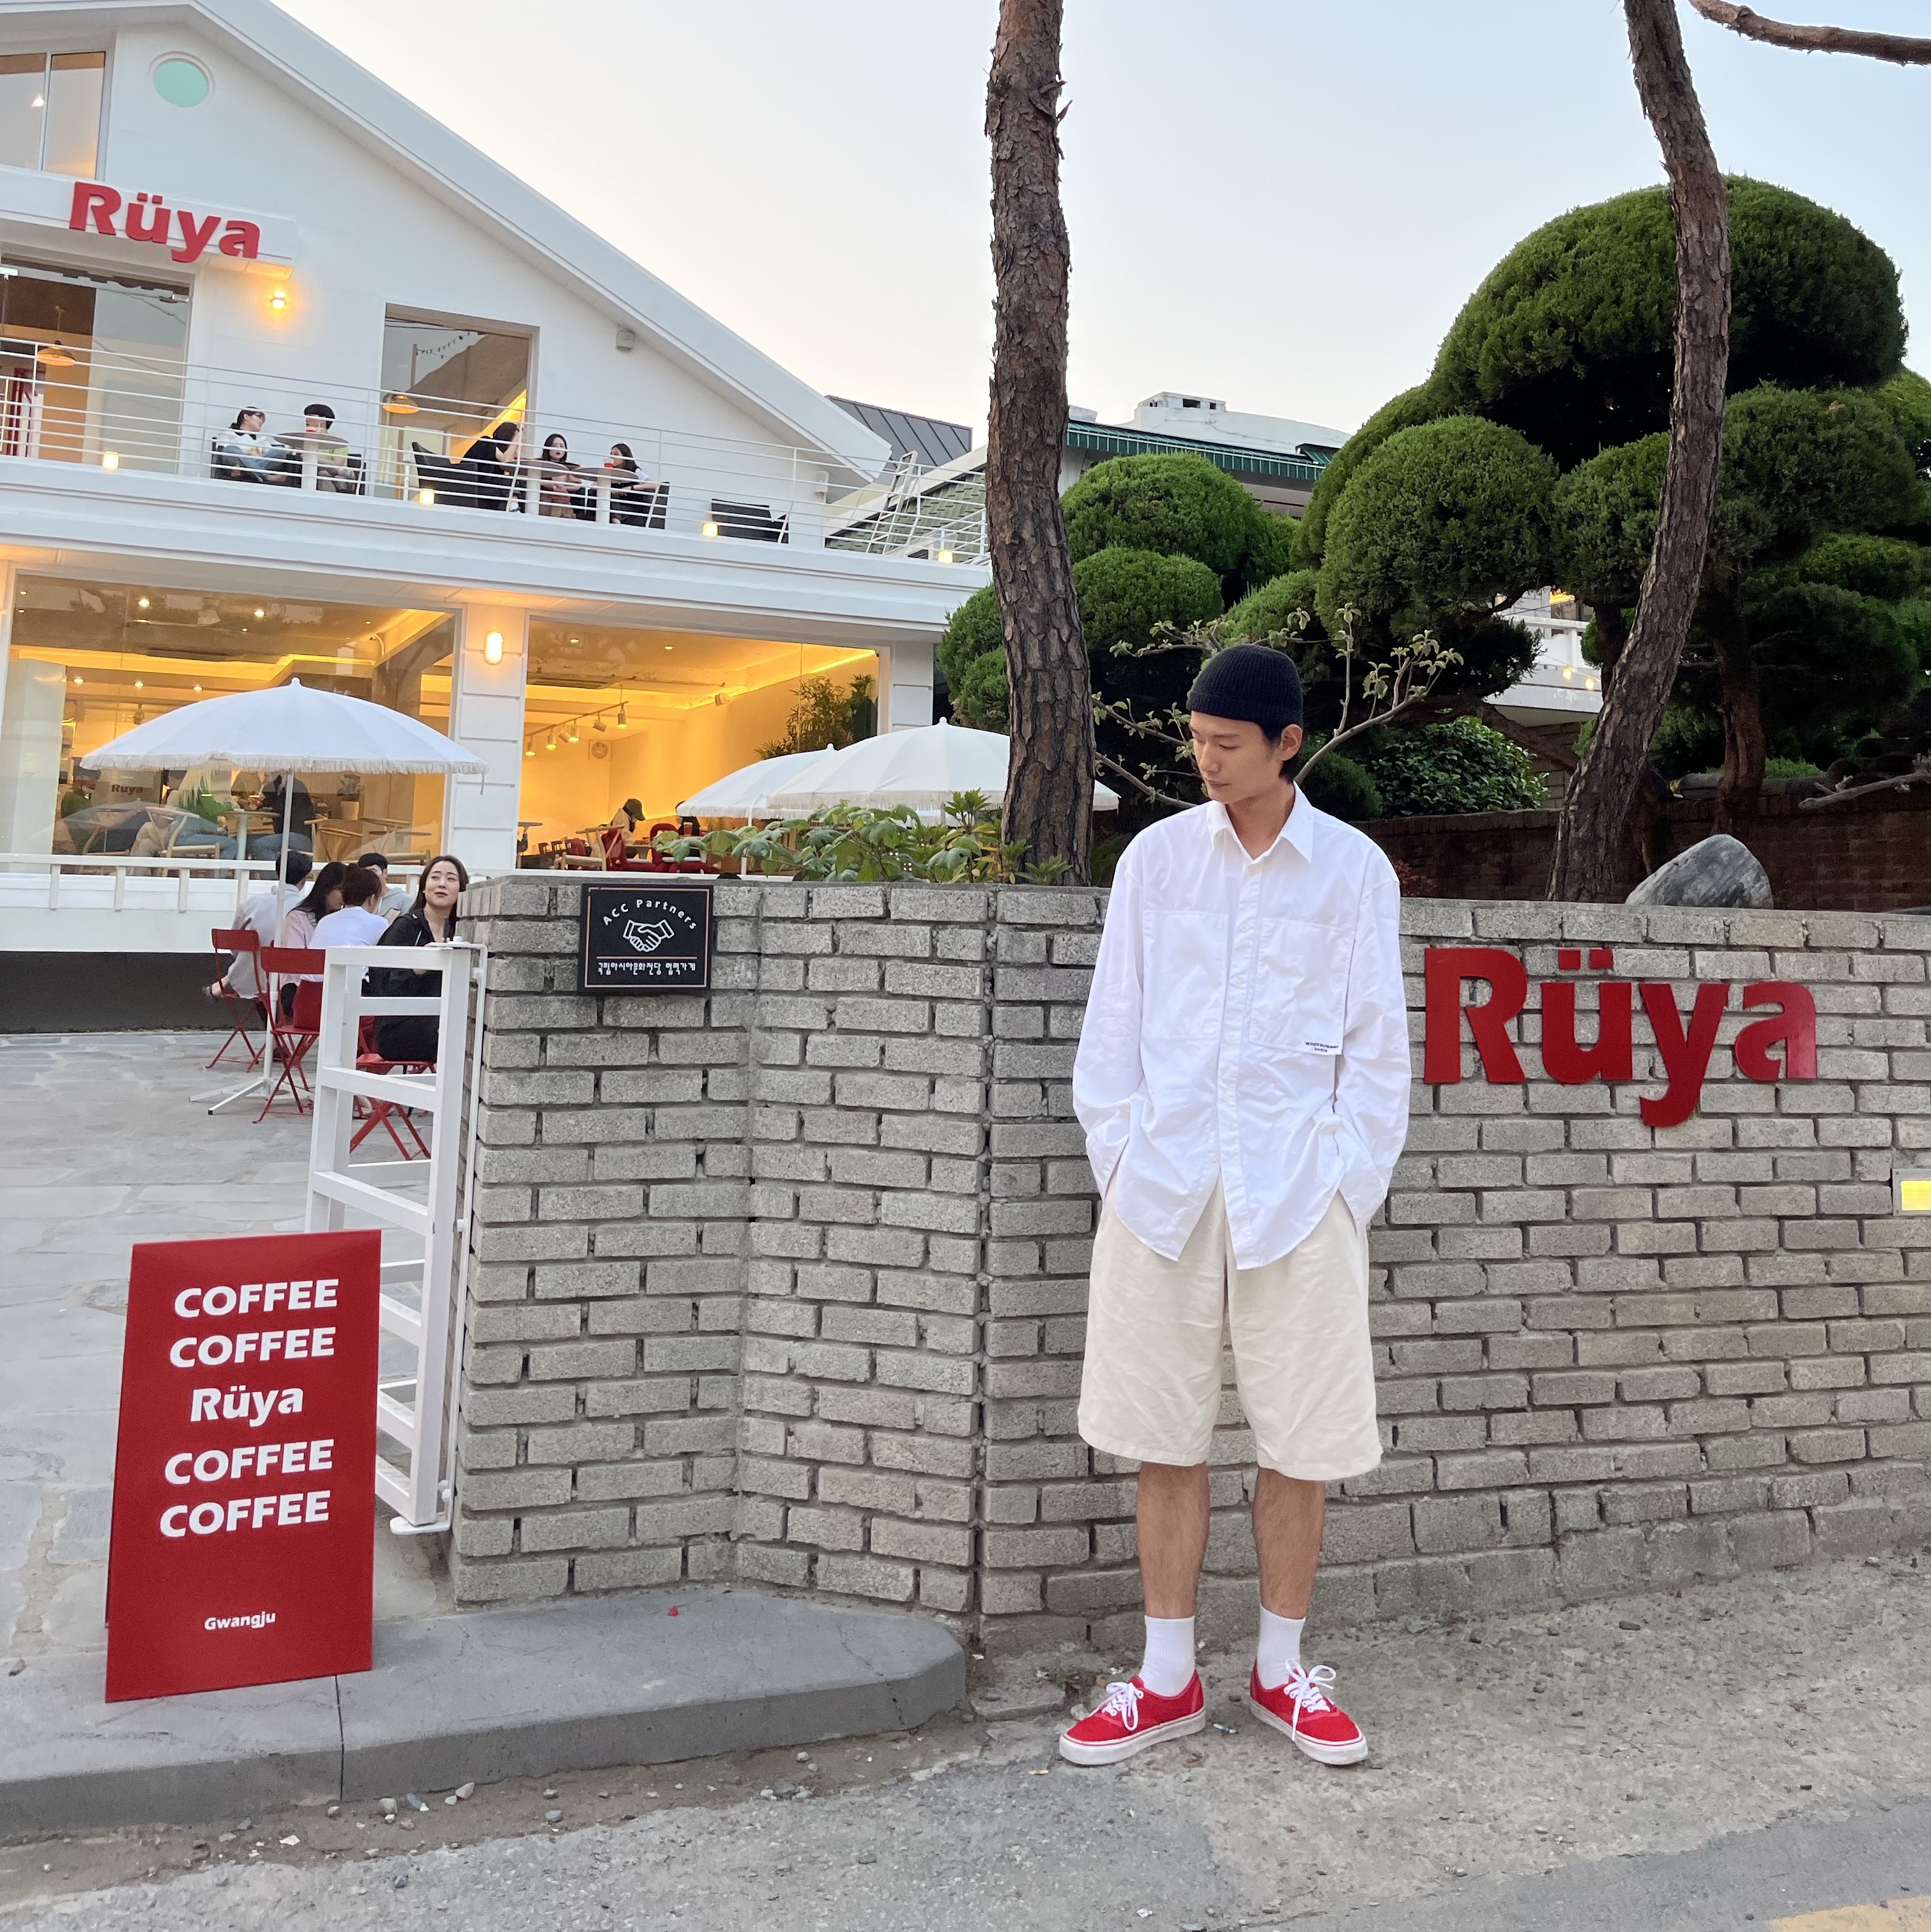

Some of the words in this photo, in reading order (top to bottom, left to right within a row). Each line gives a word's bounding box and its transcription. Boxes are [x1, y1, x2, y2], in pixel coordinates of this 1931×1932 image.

[70, 181, 260, 263] Rüya
[603, 903, 629, 926] ACC
[636, 899, 697, 930] Partners
[598, 962, 662, 976] 국립아시아문화전당
[665, 962, 696, 976] 협력가게
[1424, 947, 1817, 1128] Rüya
[174, 1278, 339, 1318] COFFEE
[169, 1326, 336, 1368] COFFEE
[190, 1384, 303, 1427] Rüya
[164, 1438, 334, 1485] COFFEE
[160, 1489, 331, 1538] COFFEE
[204, 1611, 276, 1630] Gwangju
